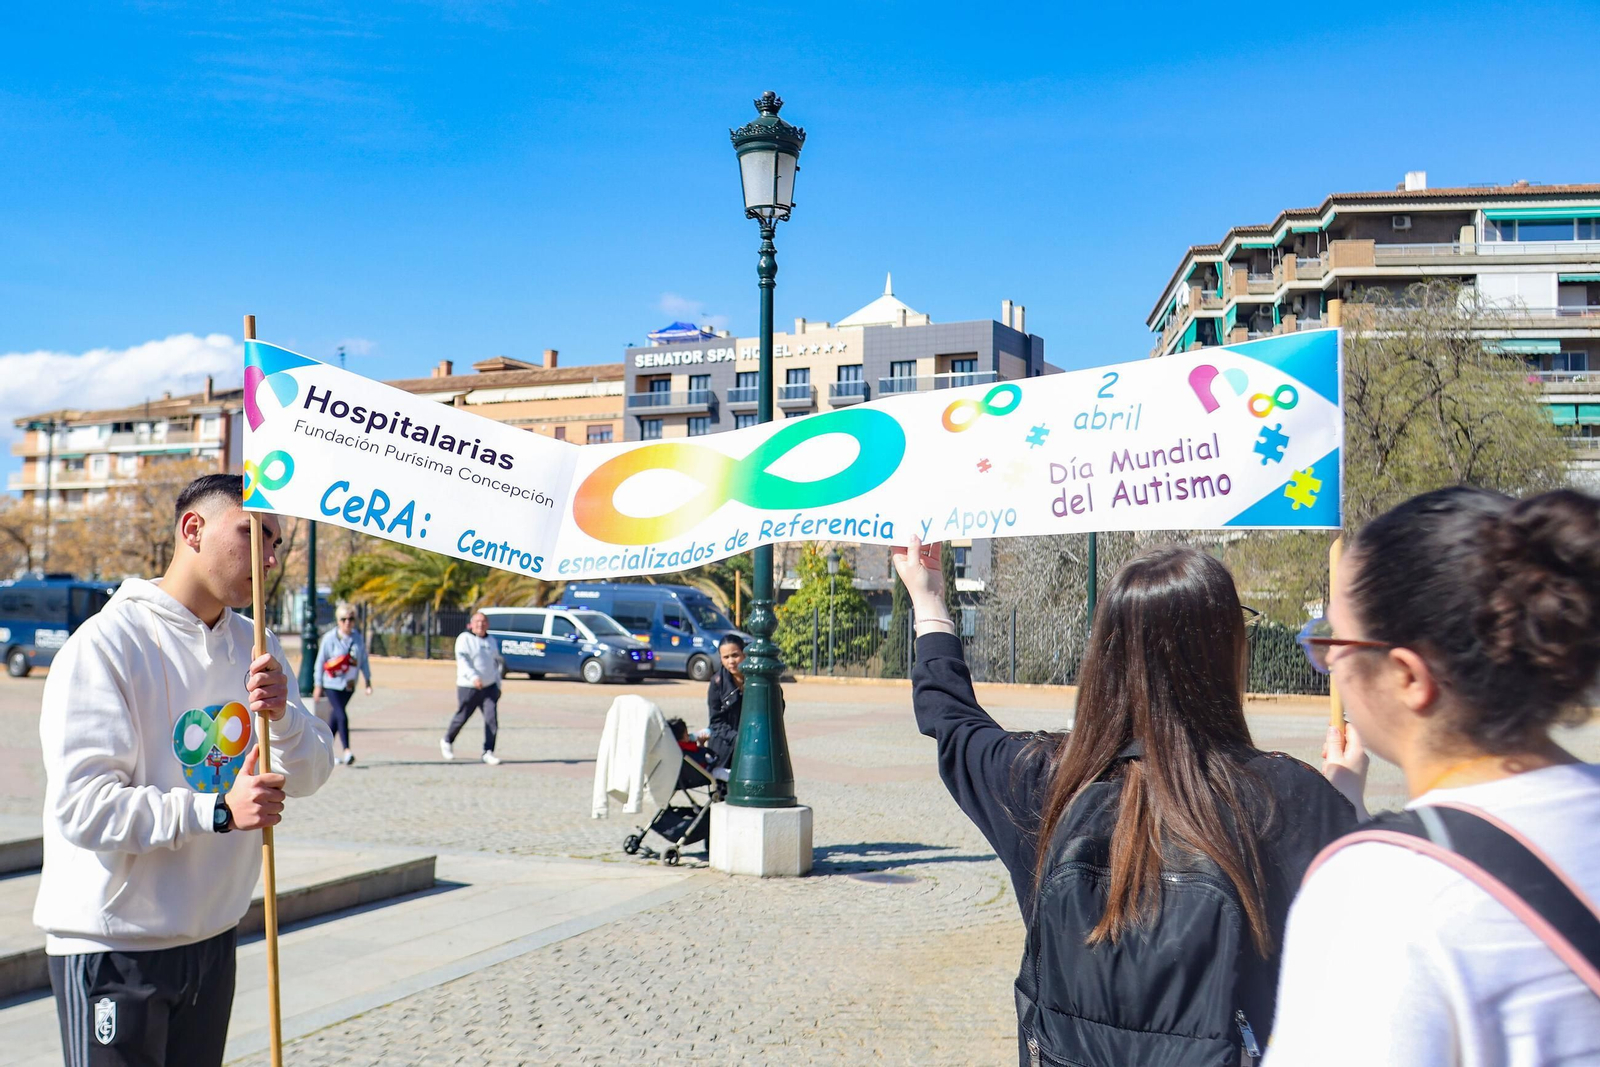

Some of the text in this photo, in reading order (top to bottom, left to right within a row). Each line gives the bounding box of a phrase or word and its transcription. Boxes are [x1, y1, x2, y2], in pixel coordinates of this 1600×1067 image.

[635, 344, 793, 368] SENATOR SPA HOEL
[1097, 372, 1119, 399] 2
[303, 385, 515, 470] Hospitalarias
[1073, 403, 1142, 431] abril
[293, 419, 554, 509] Fundación Purísima Concepción
[1049, 433, 1220, 485] Día Mundial
[1051, 472, 1232, 518] del Autismo
[320, 480, 1017, 576] CeRA: Centros especializados de Referencia y Apoyo
